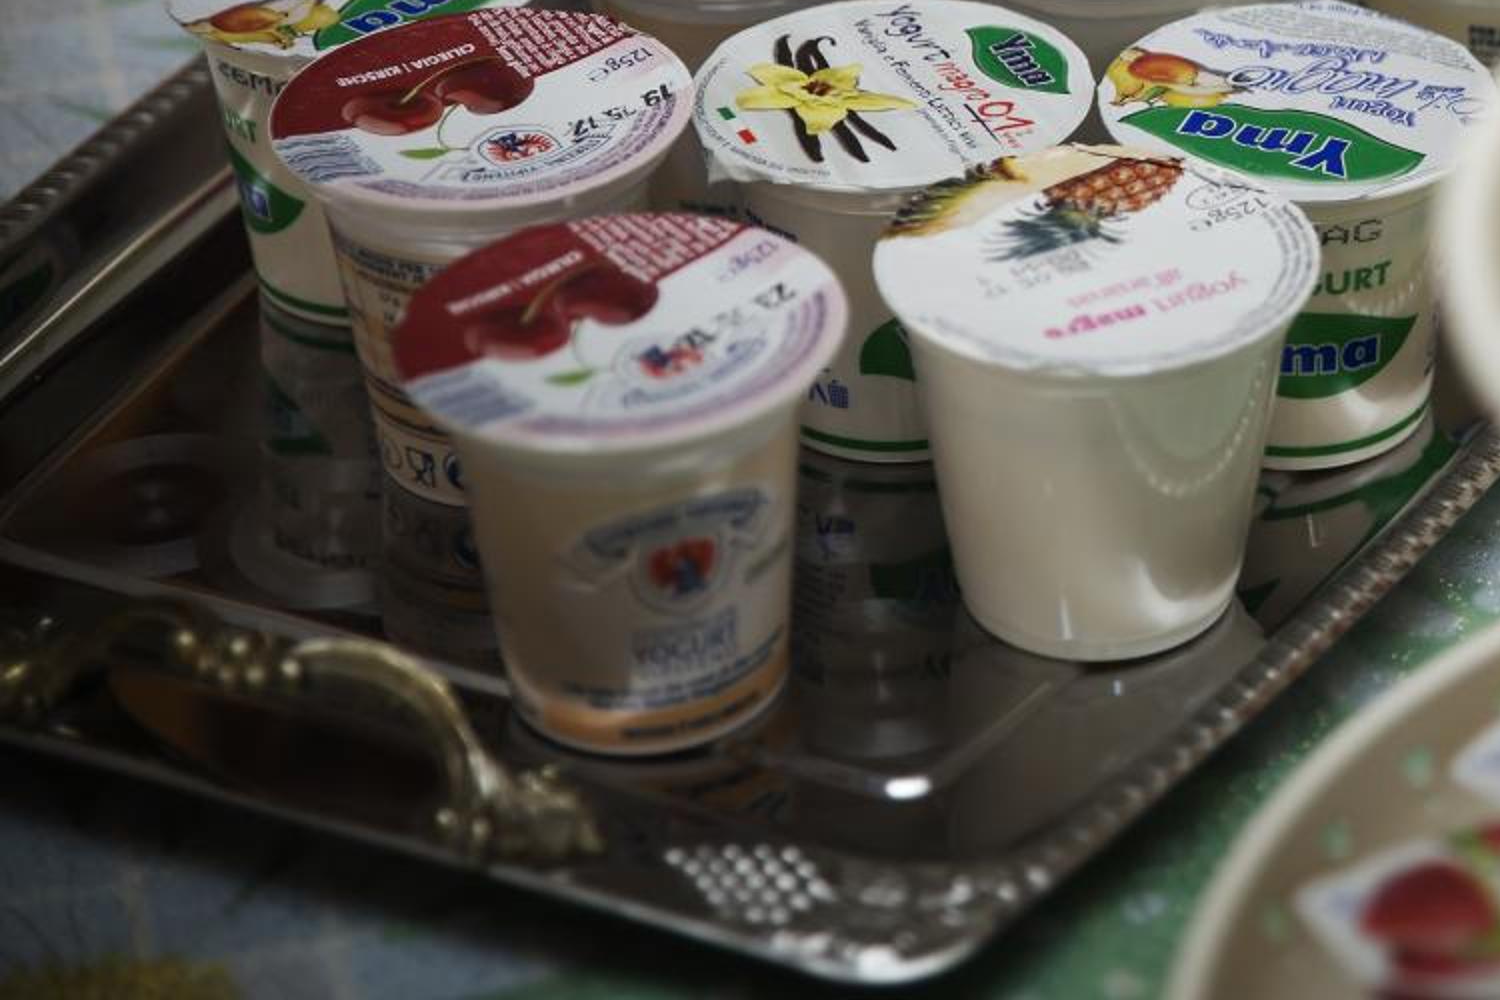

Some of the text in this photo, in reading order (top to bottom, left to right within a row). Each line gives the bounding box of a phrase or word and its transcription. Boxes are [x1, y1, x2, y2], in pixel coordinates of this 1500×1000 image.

[874, 4, 950, 61] Yogurt
[989, 31, 1055, 88] Yma
[1177, 109, 1353, 178] Yma
